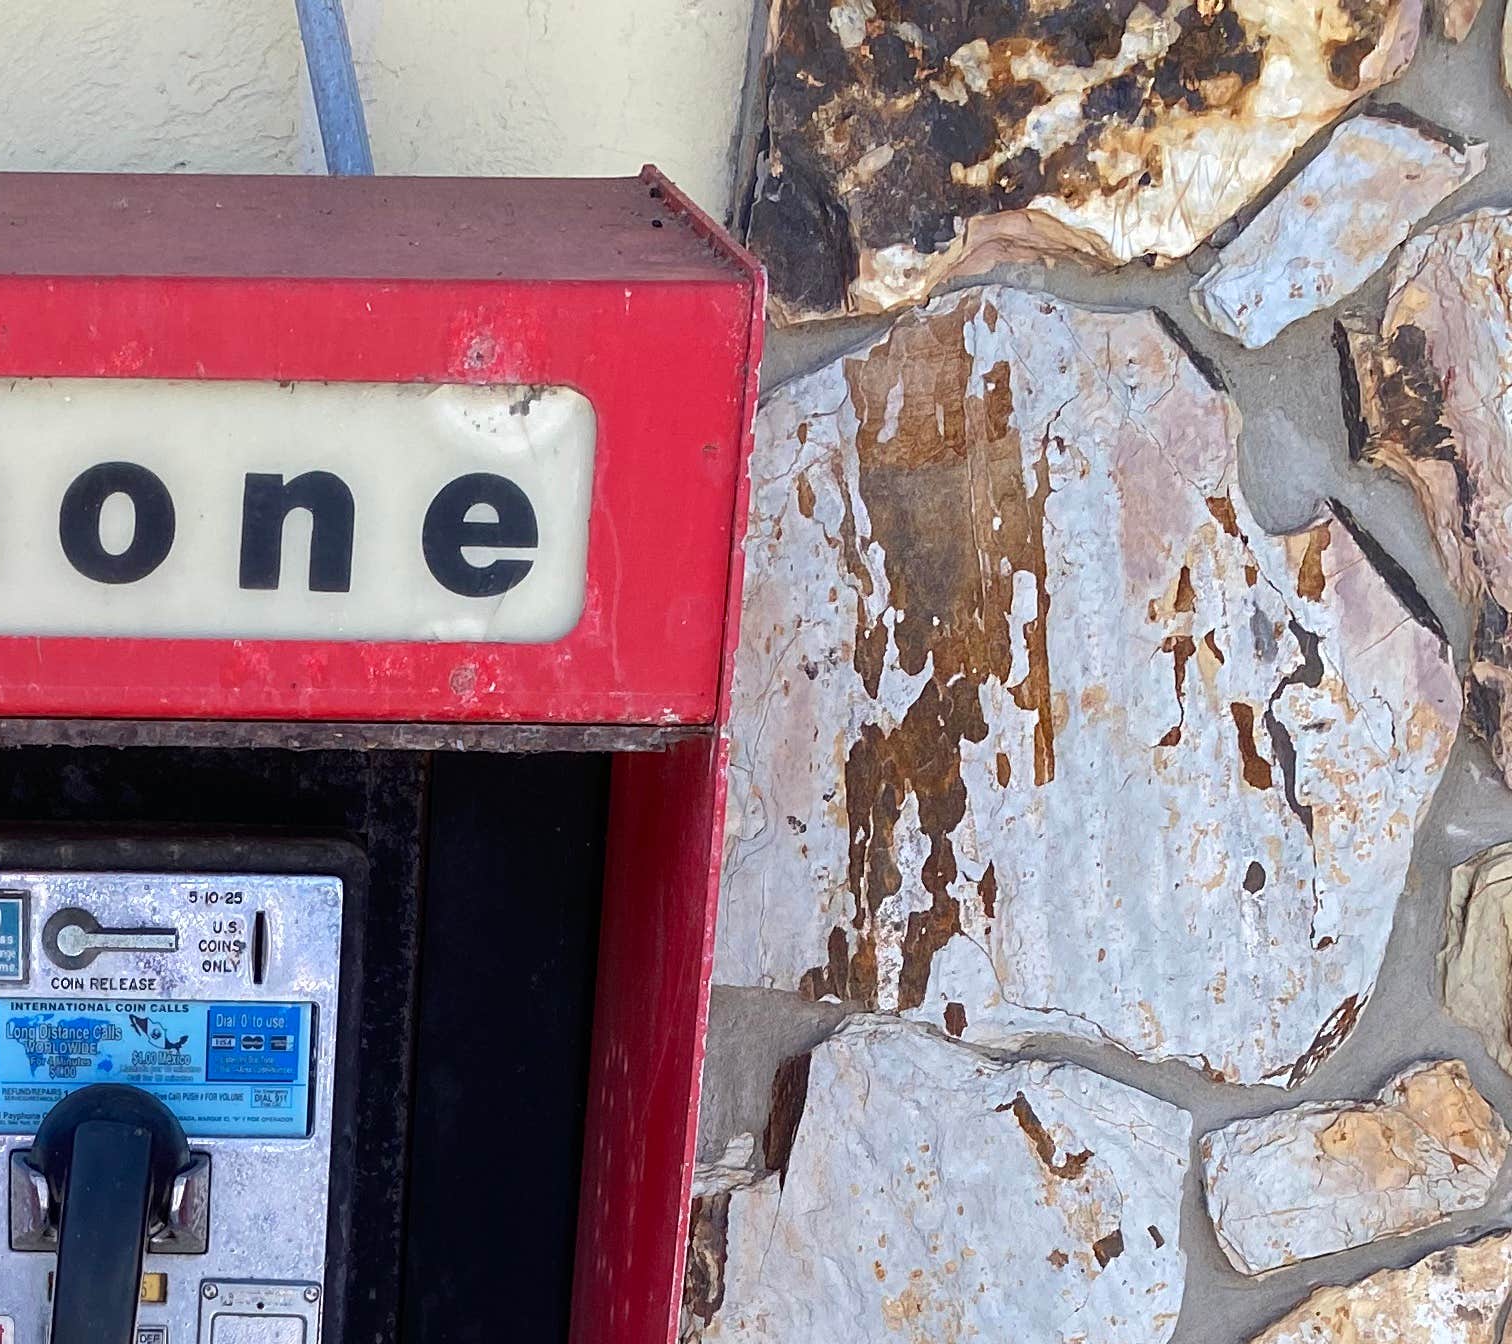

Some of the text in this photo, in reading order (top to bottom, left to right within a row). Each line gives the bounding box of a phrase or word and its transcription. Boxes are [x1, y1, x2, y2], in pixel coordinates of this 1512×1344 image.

[213, 920, 242, 934] U.S.
[198, 939, 241, 953] COINS
[202, 960, 241, 973] ONLY
[50, 977, 157, 991] COIN RELEASE
[10, 1001, 190, 1013] INTERNATIONAL COIN CALLS
[216, 1013, 236, 1028] Dial
[252, 1015, 263, 1028] to
[6, 1022, 123, 1041] Long Distance Calls
